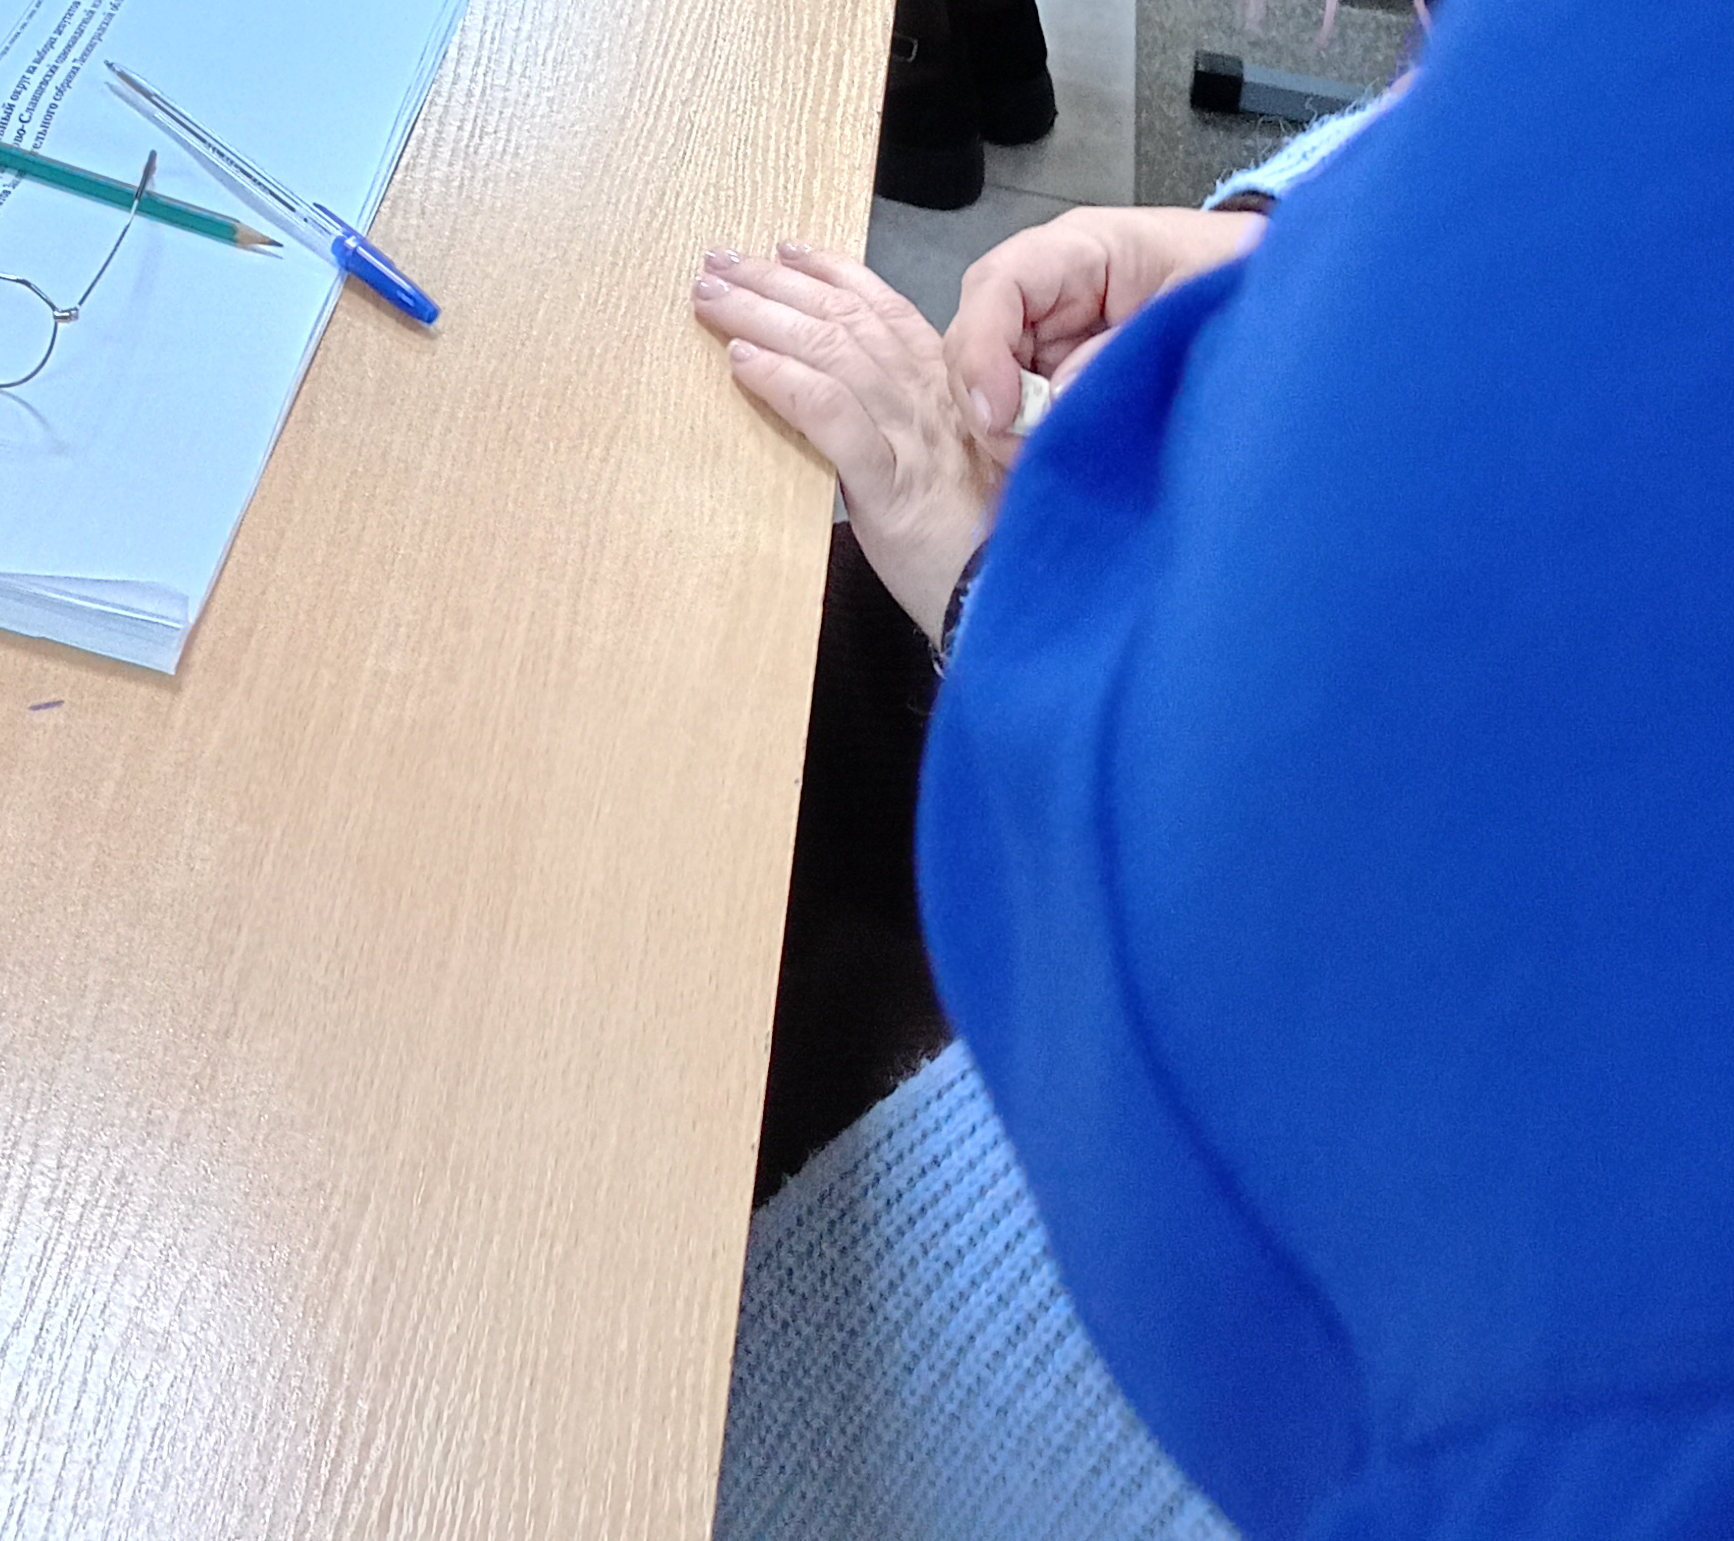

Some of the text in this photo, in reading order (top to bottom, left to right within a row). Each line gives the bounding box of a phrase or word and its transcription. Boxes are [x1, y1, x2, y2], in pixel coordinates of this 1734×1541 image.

[9, 74, 31, 102] округ
[24, 65, 37, 75] на
[53, 0, 82, 37] депутатов
[52, 65, 81, 102] собрания
[72, 11, 116, 67] Ленинградской
